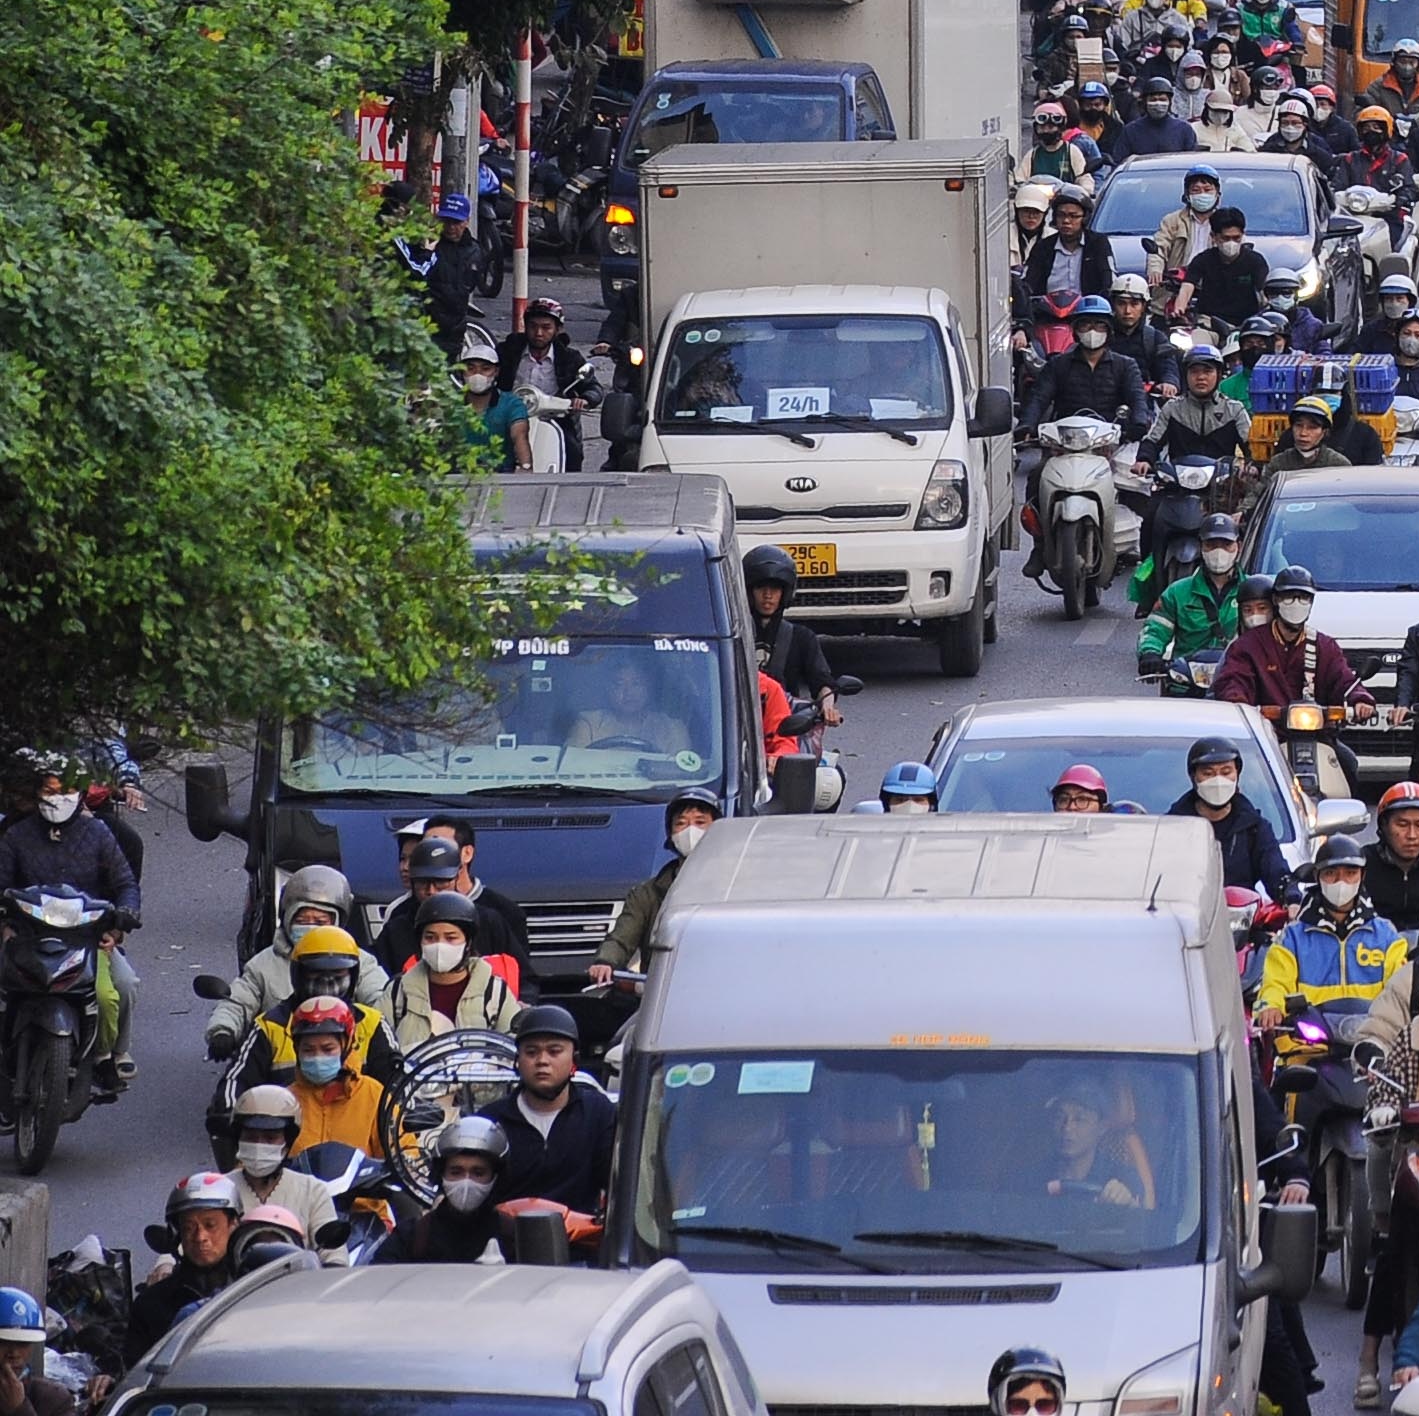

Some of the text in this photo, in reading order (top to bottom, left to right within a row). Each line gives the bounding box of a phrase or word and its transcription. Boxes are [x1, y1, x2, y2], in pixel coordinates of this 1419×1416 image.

[779, 396, 819, 413] 24/h
[789, 479, 816, 490] KIA
[1356, 942, 1385, 967] be
